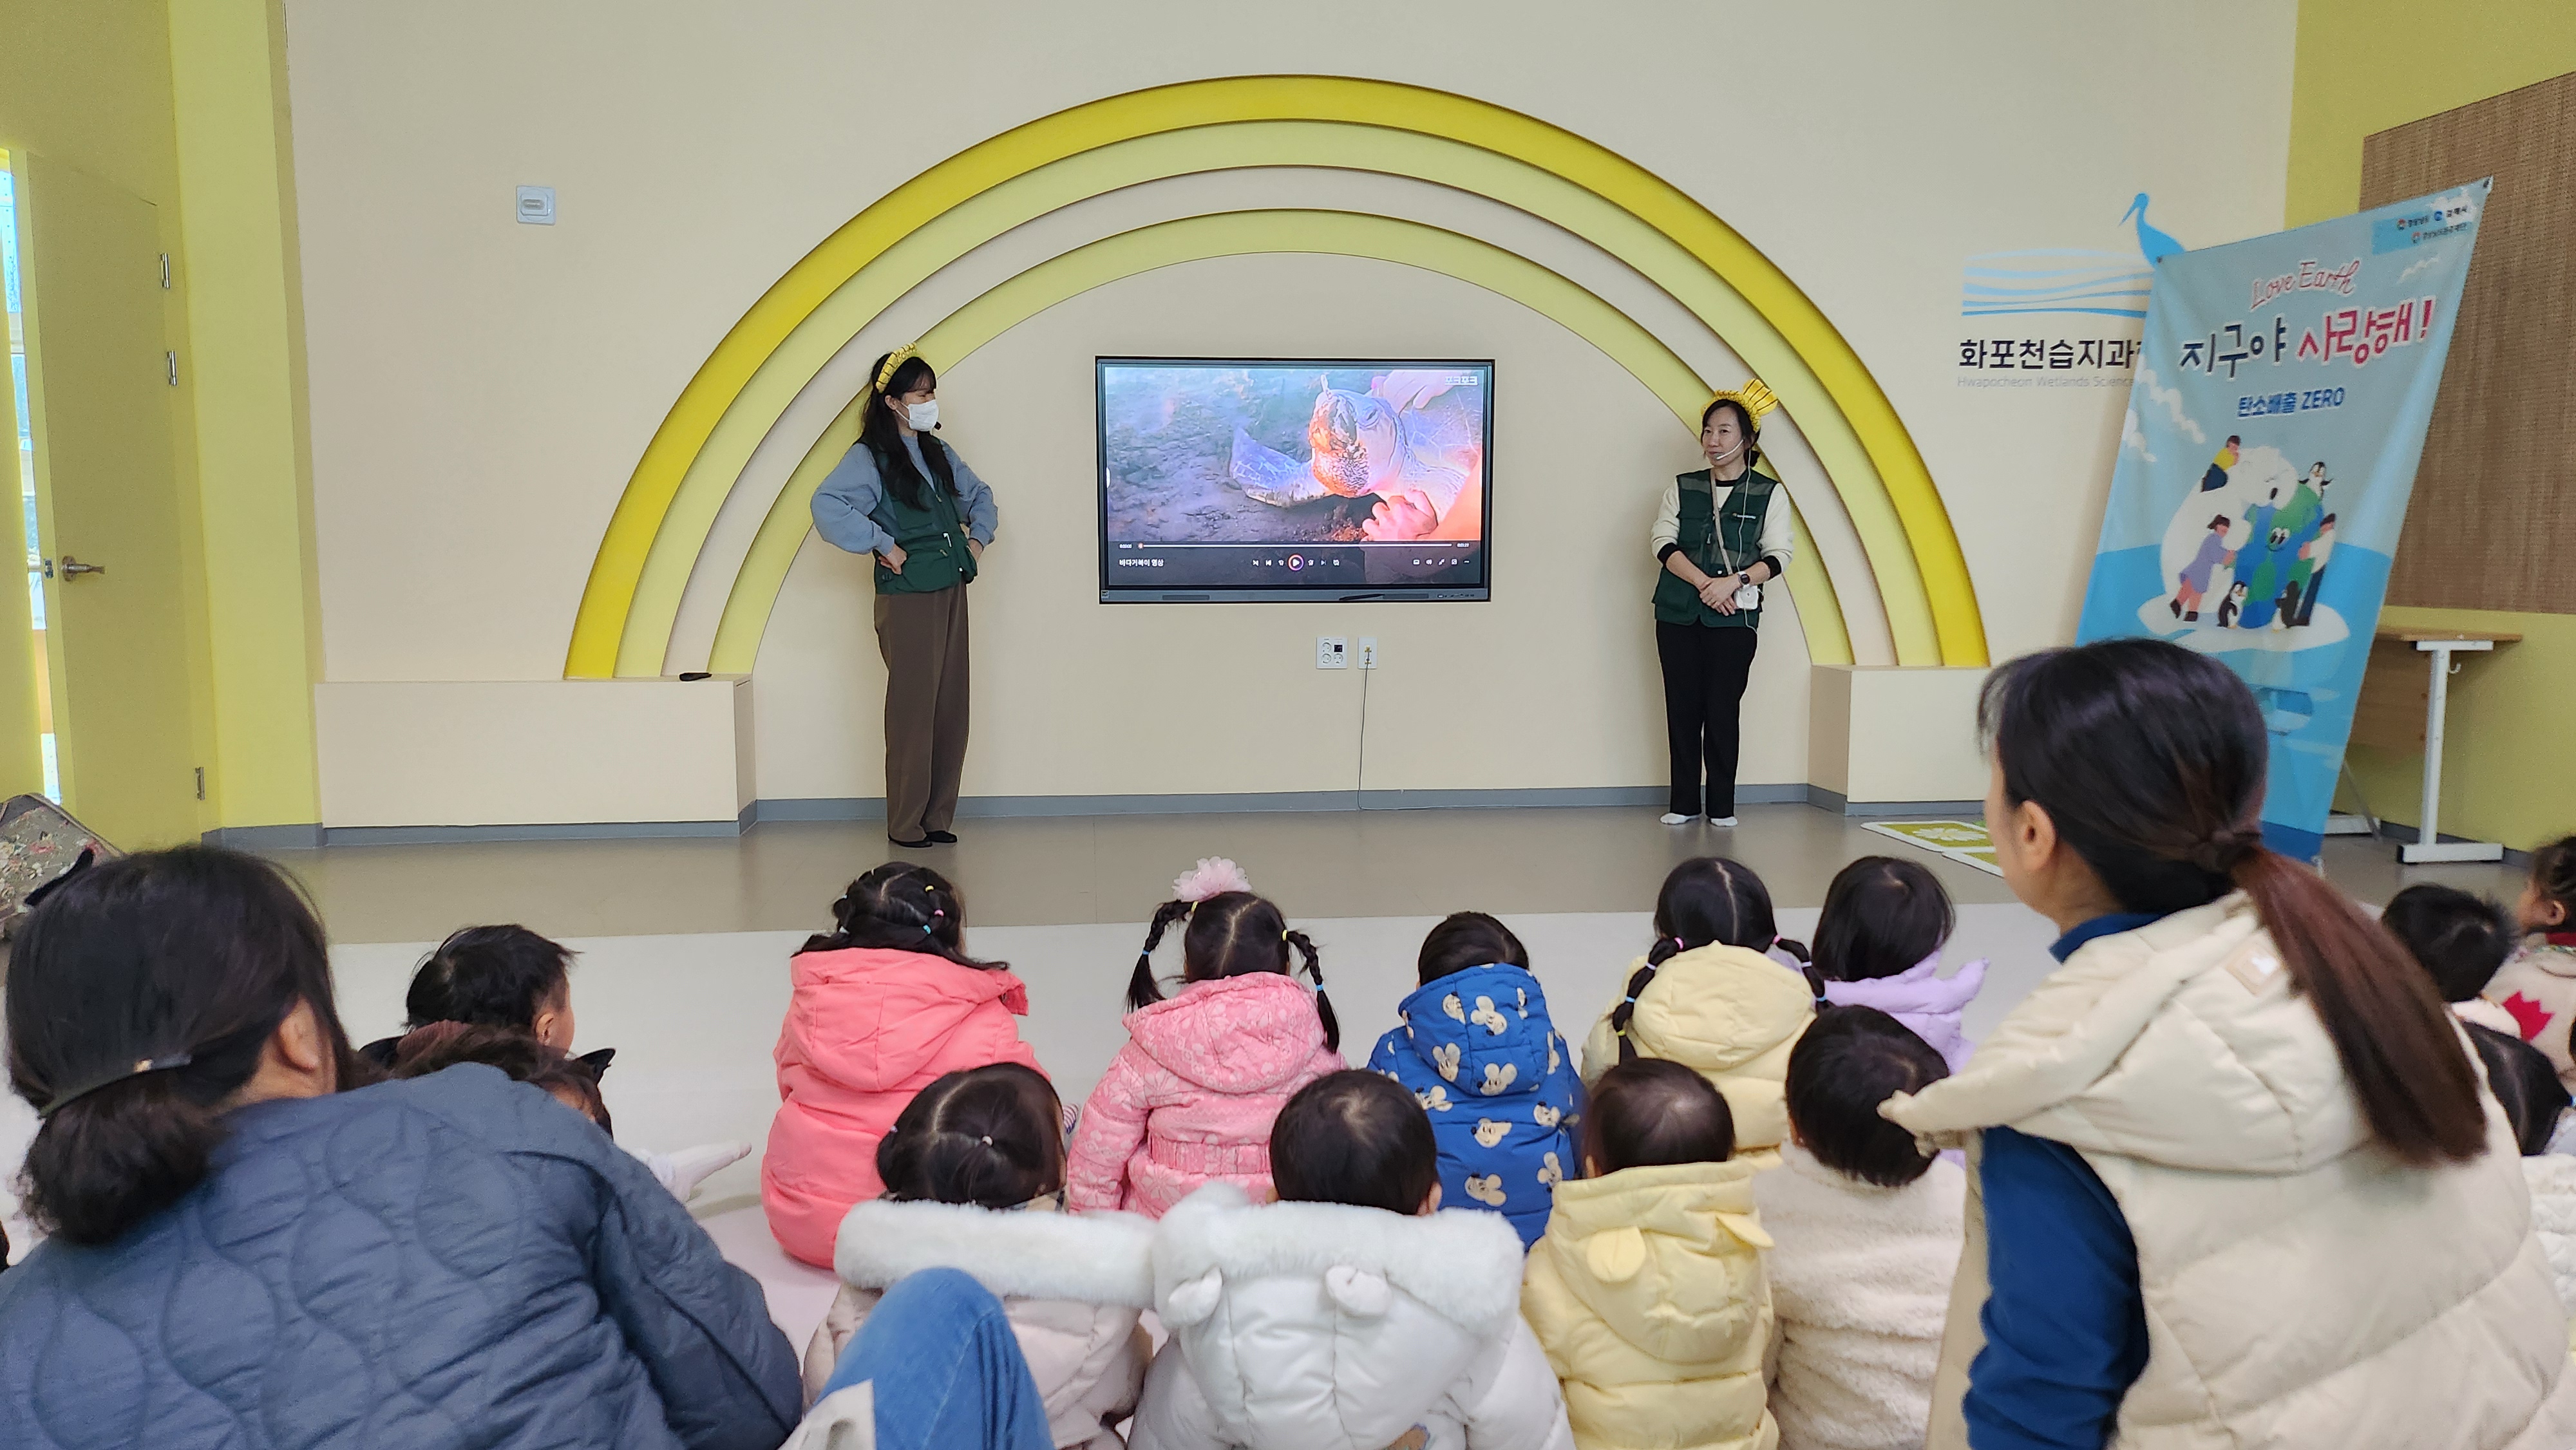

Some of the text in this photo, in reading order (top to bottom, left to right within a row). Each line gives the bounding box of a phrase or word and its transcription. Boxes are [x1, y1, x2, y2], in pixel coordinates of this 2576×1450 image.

[2251, 259, 2360, 310] Love Earth
[1958, 339, 2143, 370] 화포천습지과
[2180, 299, 2433, 379] 지구야 사랑해!
[2036, 376, 2089, 388] Wetlands
[2238, 386, 2345, 417] 탄소배출 ZERO
[1119, 558, 1164, 567] 바다거북이 영상
